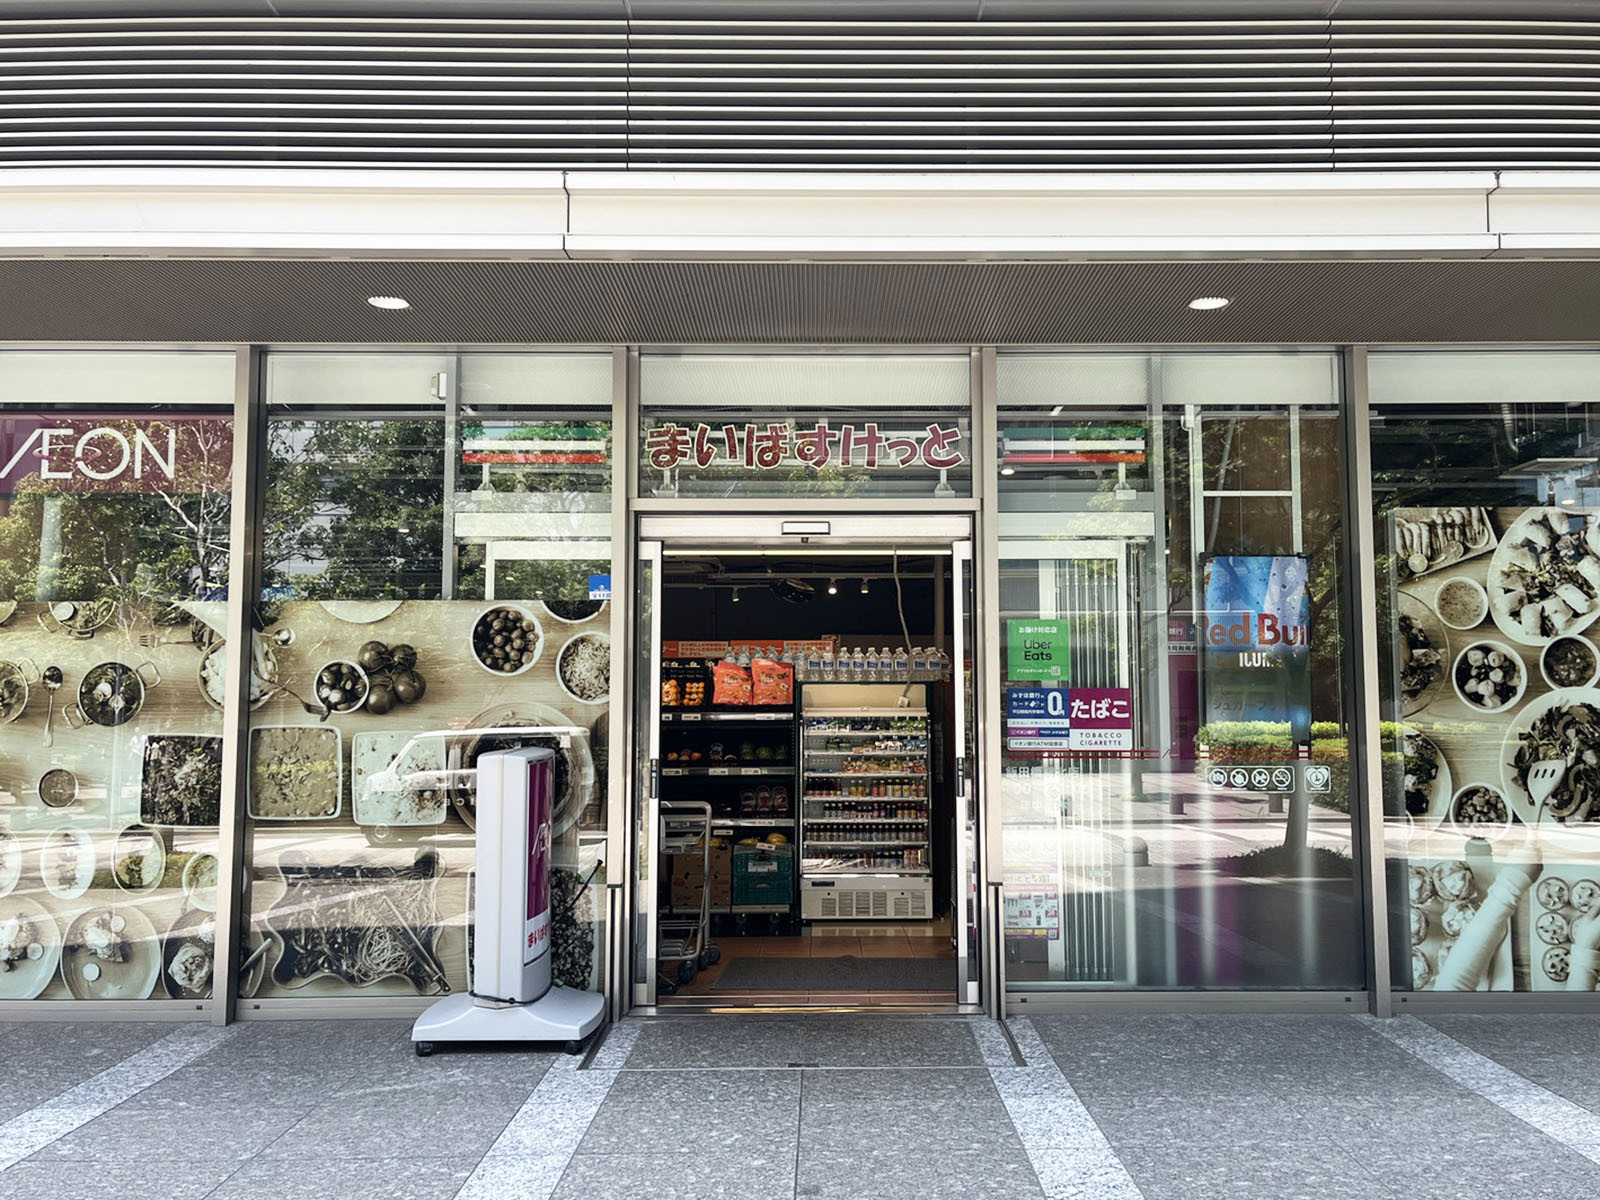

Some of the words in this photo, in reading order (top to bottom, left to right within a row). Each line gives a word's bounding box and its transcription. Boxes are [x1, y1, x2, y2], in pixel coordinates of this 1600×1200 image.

[645, 422, 966, 470] まいばすけっと
[1024, 639, 1052, 650] Uber
[1024, 650, 1053, 661] Eats
[1070, 697, 1130, 719] たばこ
